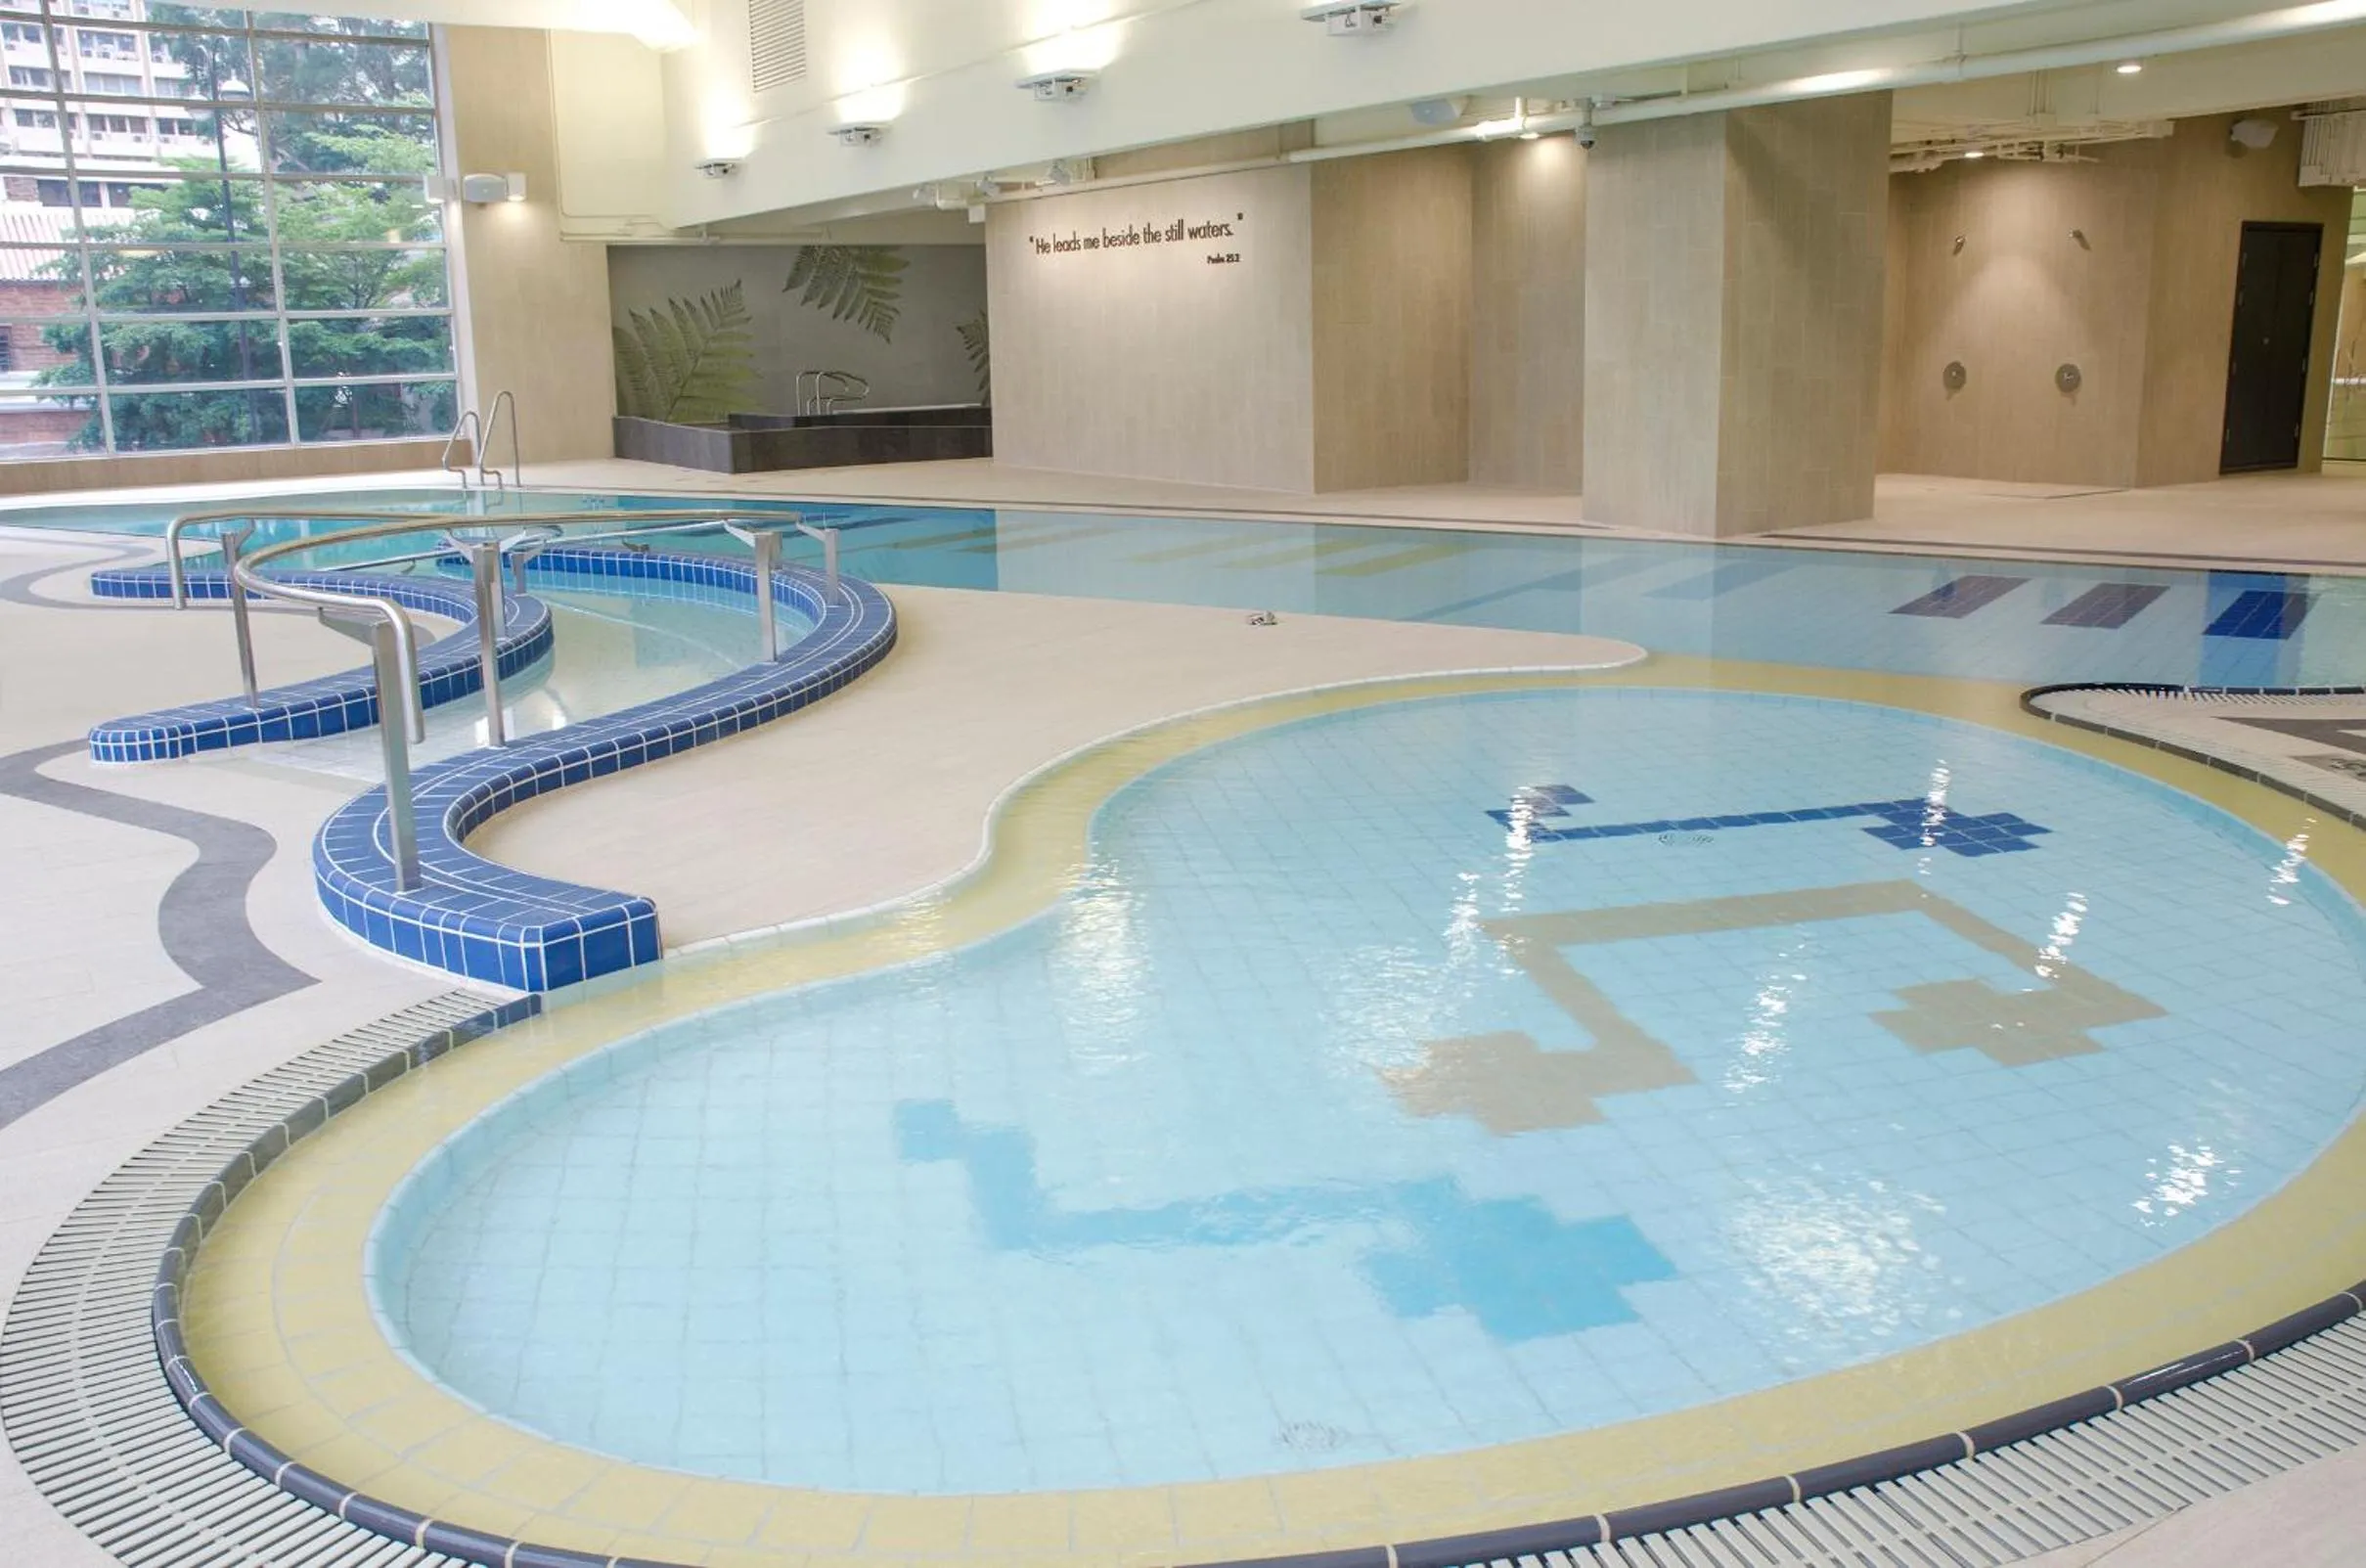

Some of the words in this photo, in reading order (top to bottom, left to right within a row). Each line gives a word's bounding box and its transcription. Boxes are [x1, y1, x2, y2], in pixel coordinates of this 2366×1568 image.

[1052, 231, 1082, 253] leads
[1083, 237, 1100, 249] me
[1102, 223, 1140, 248] beside
[1142, 222, 1162, 244] the
[1165, 219, 1184, 243] still
